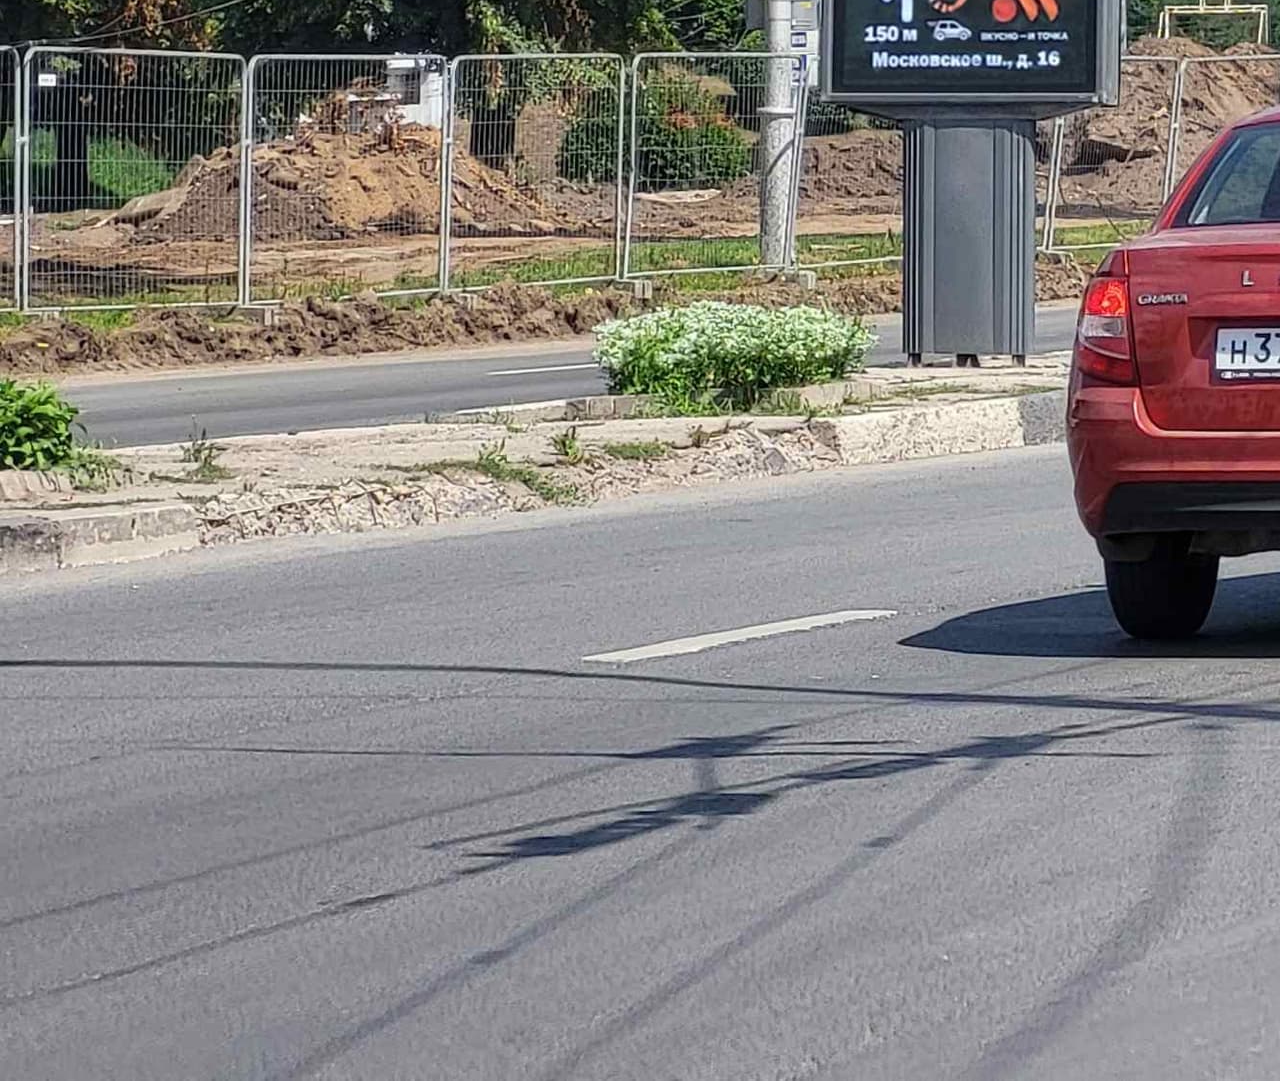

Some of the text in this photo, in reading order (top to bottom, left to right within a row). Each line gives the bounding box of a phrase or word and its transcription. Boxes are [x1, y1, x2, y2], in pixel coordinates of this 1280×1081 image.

[864, 26, 918, 42] 150 м
[1037, 31, 1069, 41] ТОЧКА
[872, 52, 982, 68] Московское
[1016, 53, 1033, 69] д.
[1037, 50, 1061, 67] 16
